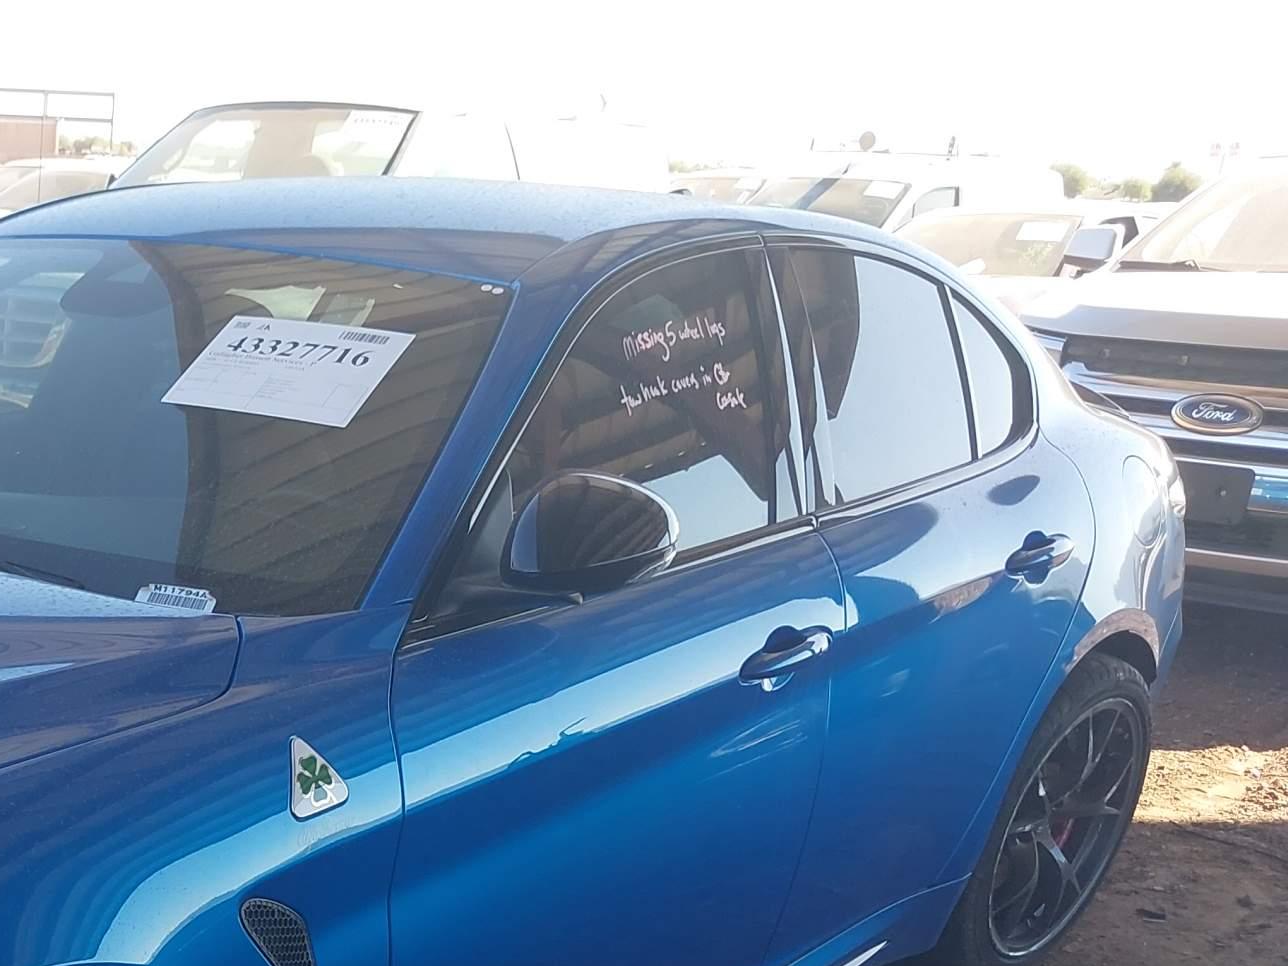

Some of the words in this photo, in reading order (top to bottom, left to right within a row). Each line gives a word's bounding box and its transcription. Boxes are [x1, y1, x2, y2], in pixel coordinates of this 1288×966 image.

[665, 320, 676, 346] 5
[678, 316, 704, 340] wheel
[227, 335, 376, 367] 43327716
[700, 365, 712, 386] in
[1191, 402, 1235, 422] Ford
[153, 585, 208, 599] M11794A
